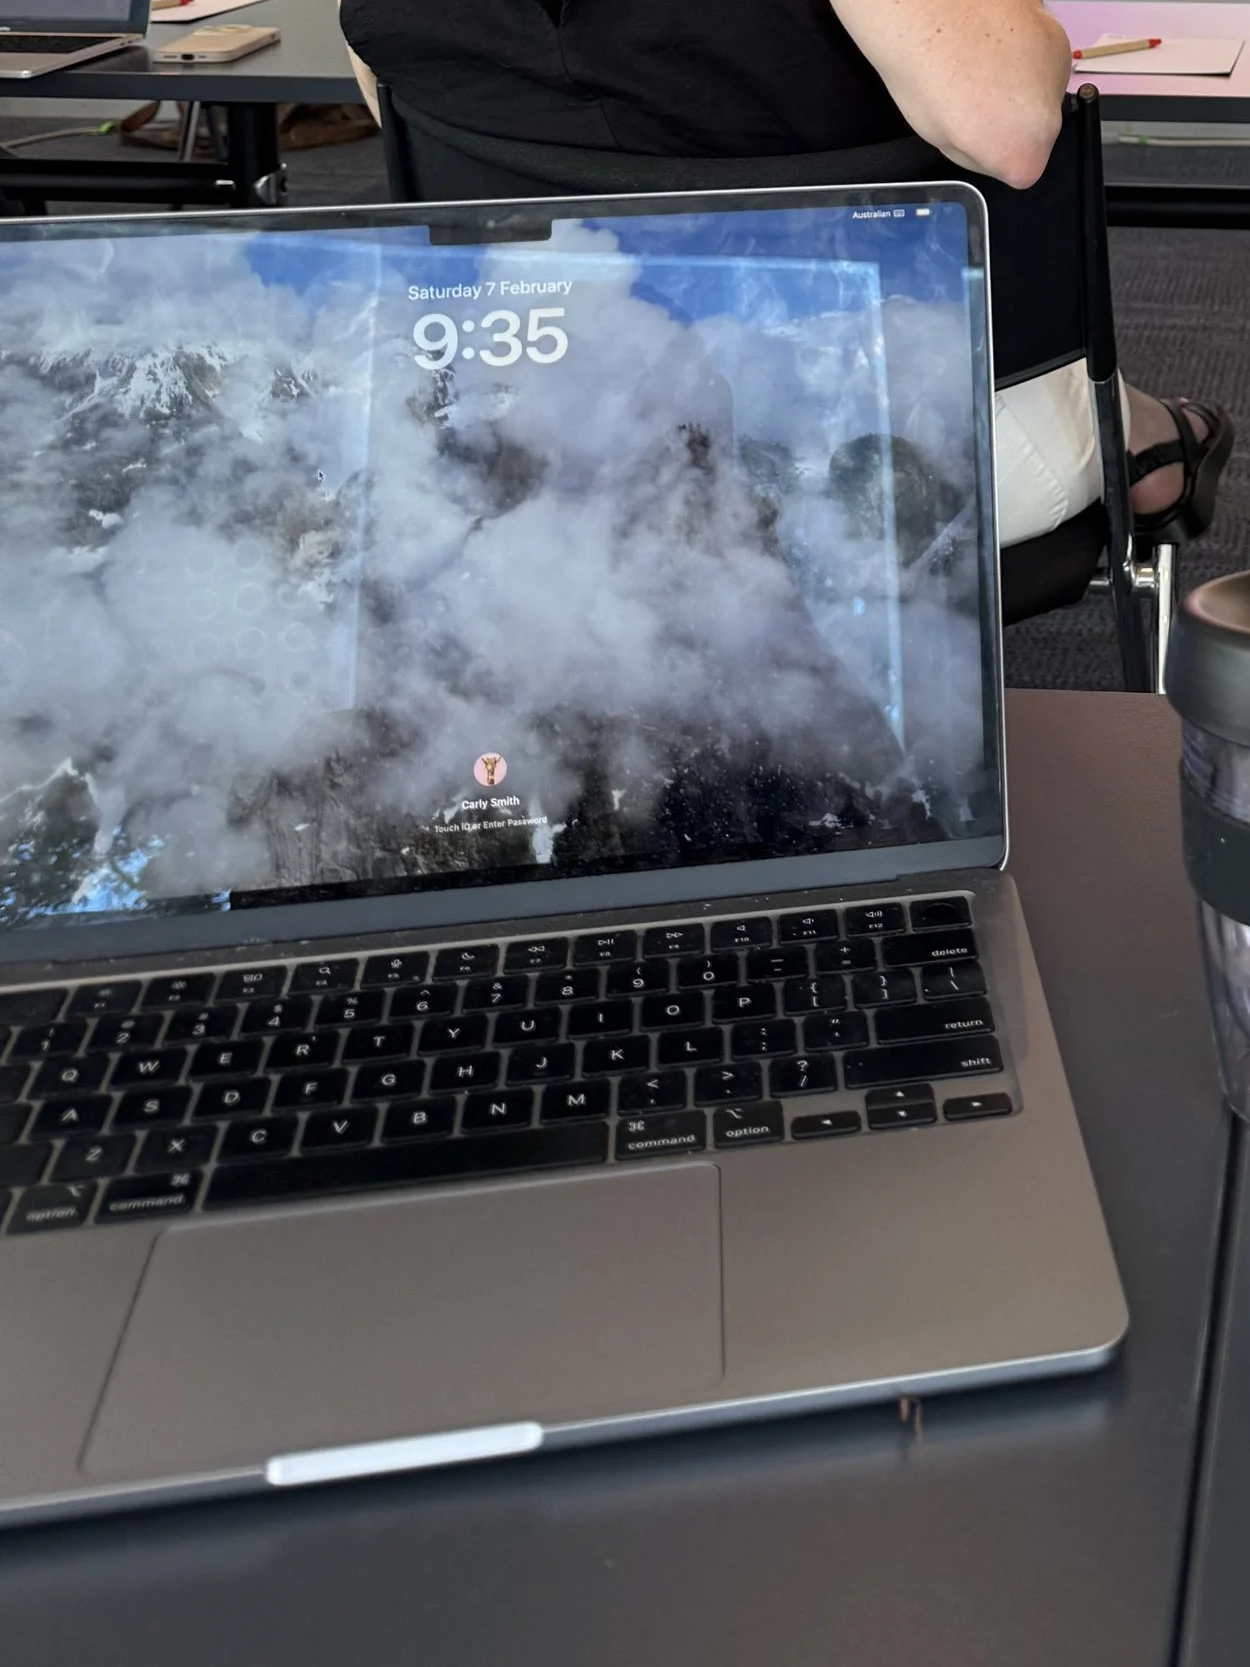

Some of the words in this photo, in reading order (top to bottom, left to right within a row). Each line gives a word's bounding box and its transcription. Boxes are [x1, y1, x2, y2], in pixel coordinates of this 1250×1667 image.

[852, 209, 891, 219] Australian
[407, 283, 482, 301] Saturday
[486, 282, 496, 296] 7
[500, 280, 573, 295] February
[413, 307, 569, 370] 9:35
[461, 797, 488, 811] Carly
[490, 795, 520, 808] Smith
[434, 824, 460, 834] Touch
[483, 820, 505, 830] Enter
[507, 815, 548, 827] Password
[931, 945, 968, 958] delete
[632, 978, 644, 988] 9
[562, 986, 574, 996] 8
[491, 994, 501, 1003] 7
[738, 997, 751, 1008] P
[416, 1001, 429, 1011] 6
[666, 1005, 680, 1016] O
[343, 1008, 355, 1019] 5
[267, 1016, 281, 1027] 4
[521, 1020, 535, 1031] U
[944, 1018, 983, 1030] return
[448, 1028, 460, 1039] Y
[373, 1036, 386, 1047] T
[686, 1041, 697, 1052] L
[296, 1044, 310, 1056] R
[611, 1049, 625, 1061] K
[219, 1052, 232, 1064] E
[535, 1057, 548, 1069] J
[961, 1055, 991, 1068] shift
[138, 1060, 160, 1074] W
[457, 1065, 474, 1078] H
[61, 1068, 79, 1083] Q
[381, 1074, 397, 1086] G
[304, 1082, 318, 1095] F
[223, 1090, 240, 1105] D
[567, 1093, 586, 1106] M
[143, 1098, 160, 1113] S
[490, 1102, 507, 1115] N
[61, 1107, 79, 1122] A
[412, 1110, 428, 1124] B
[333, 1119, 349, 1134] V
[726, 1125, 770, 1139] option
[251, 1129, 267, 1144] C
[628, 1134, 696, 1150] command
[168, 1137, 185, 1153] X
[85, 1145, 103, 1163] Z
[109, 1194, 185, 1211] command
